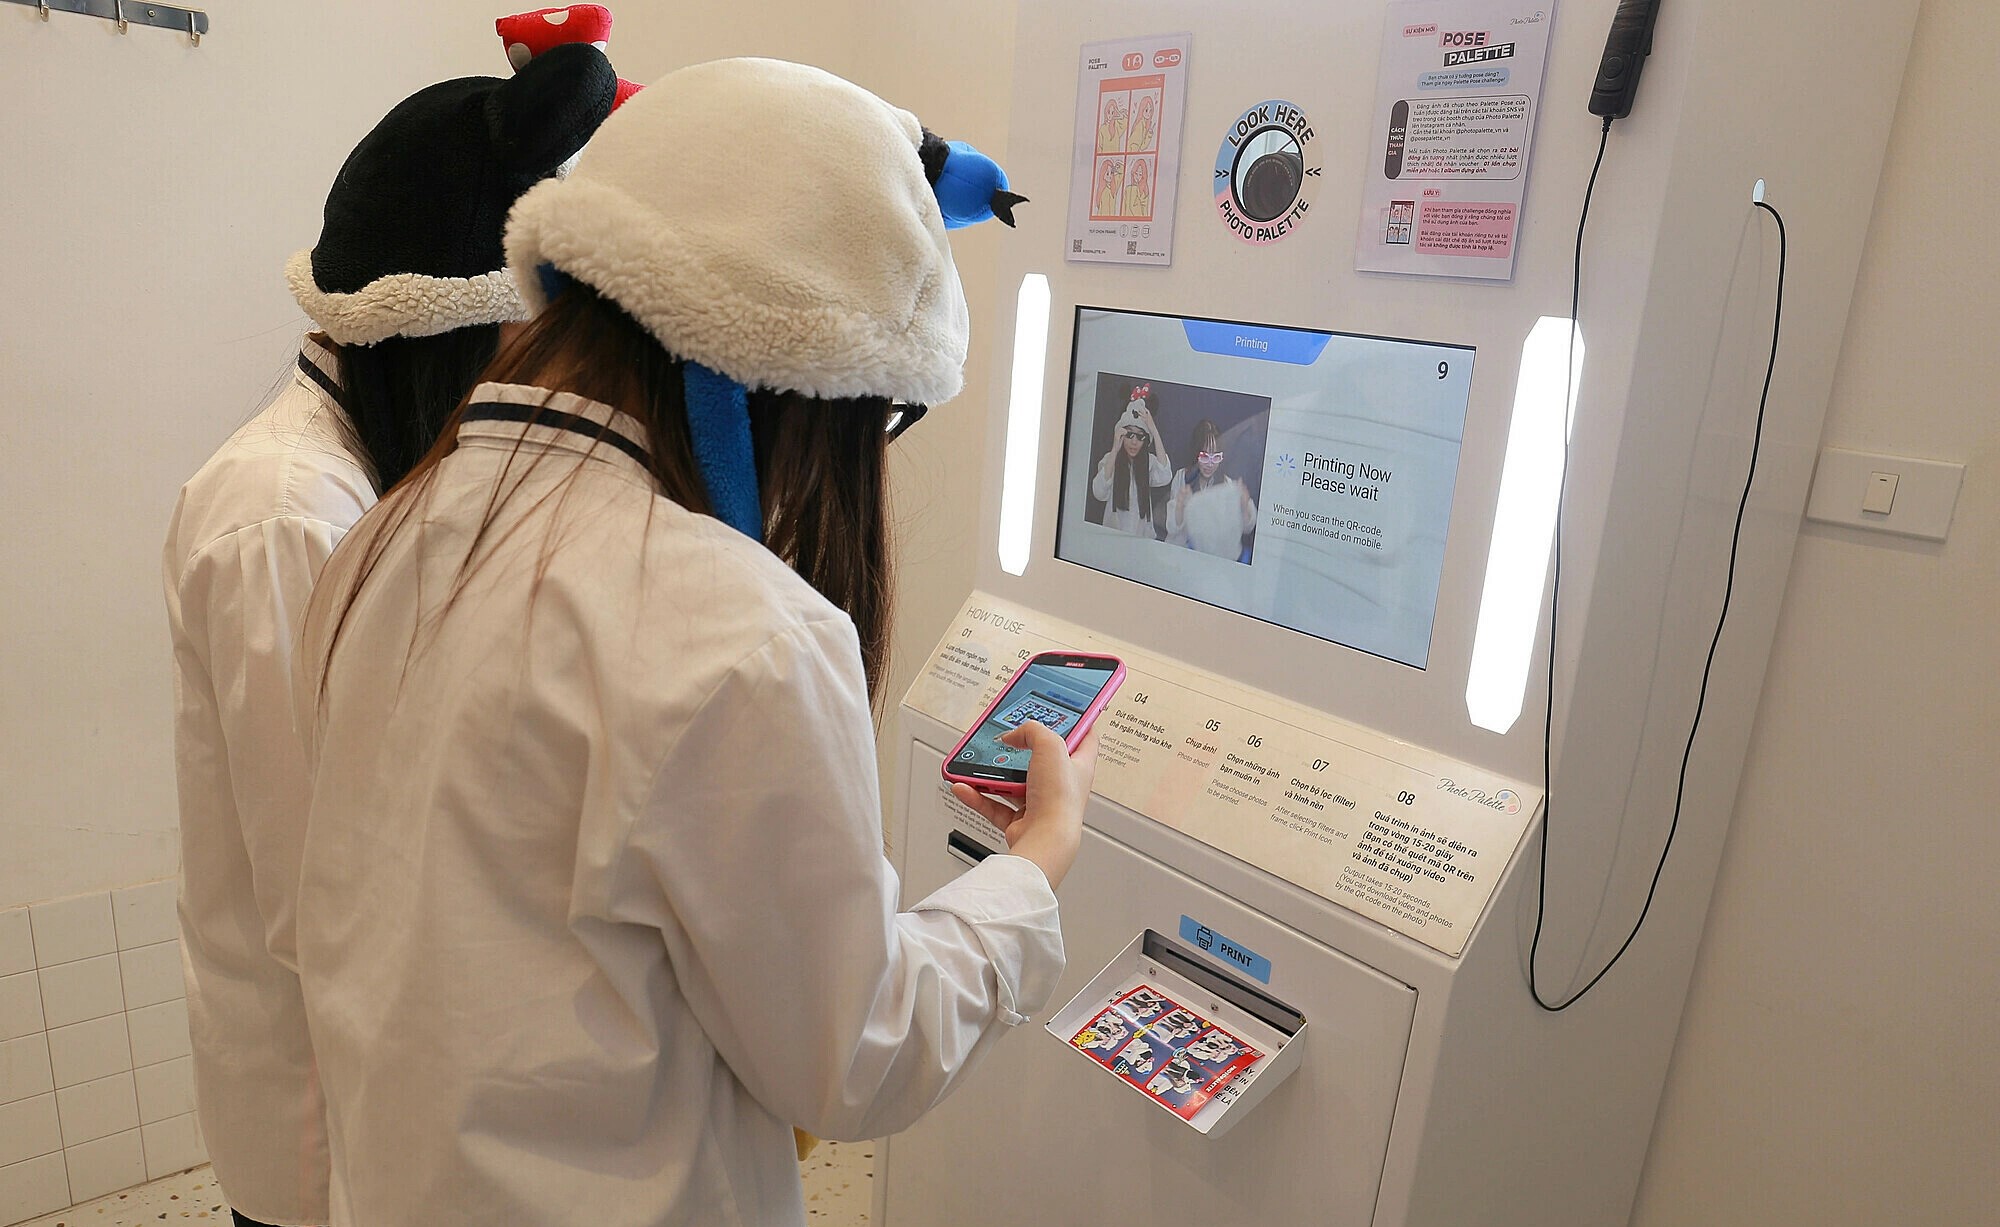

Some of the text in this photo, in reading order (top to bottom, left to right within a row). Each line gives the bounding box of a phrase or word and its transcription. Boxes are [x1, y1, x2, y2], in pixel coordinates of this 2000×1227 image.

[1442, 32, 1486, 46] POSE
[1448, 44, 1511, 65] PALETTE
[1228, 104, 1315, 147] LOOK HERE
[1220, 198, 1309, 241] PHOTO PALETTE
[1235, 335, 1268, 352] Printing
[1437, 361, 1449, 380] 9
[1304, 452, 1392, 483] Printing Now
[1301, 471, 1379, 501] Please wait
[1271, 517, 1383, 550] you can download on mobile.
[1273, 503, 1383, 538] When you scan the QR-code,
[961, 628, 972, 638] 01
[966, 606, 1025, 635] HOW TO USE
[1017, 649, 1031, 660] 02
[1134, 693, 1148, 704] 04
[1205, 719, 1221, 732] 05
[1247, 734, 1262, 748] 06
[1220, 763, 1260, 785] bạn muốn in
[1226, 753, 1280, 779] Chọn những ảnh
[1312, 758, 1330, 773] 07
[1211, 778, 1268, 807] Please choose photos
[1284, 790, 1324, 811] và hình nền
[1290, 778, 1356, 810] Chọn bộ lọc (filter)
[1397, 790, 1416, 806] 08
[1437, 778, 1505, 811] Photo Palette
[1275, 805, 1349, 840] After selecting filters and
[1374, 810, 1390, 823] Quá
[1391, 817, 1410, 830] trình
[1410, 824, 1419, 834] in
[1420, 828, 1436, 841] ảnh
[1436, 836, 1448, 845] sẽ
[1467, 848, 1478, 858] ra
[1368, 821, 1454, 861] trong vòng 15-20 giây
[1351, 851, 1413, 883] và ảnh đã chụp)
[1357, 840, 1446, 883] ảnh để tải xuống video
[1362, 830, 1475, 882] (Bạn có thể quét mã QR trên
[1343, 865, 1365, 880] Output
[1365, 873, 1383, 888] takes
[1384, 883, 1402, 896] 15-20
[1334, 880, 1344, 890] by
[1343, 884, 1355, 894] the
[1354, 889, 1365, 899] QR
[1365, 894, 1382, 907] code
[1381, 903, 1391, 911] on
[1391, 905, 1402, 916] the
[1339, 872, 1454, 928] (You can download video and photos
[1220, 943, 1252, 967] PRINT
